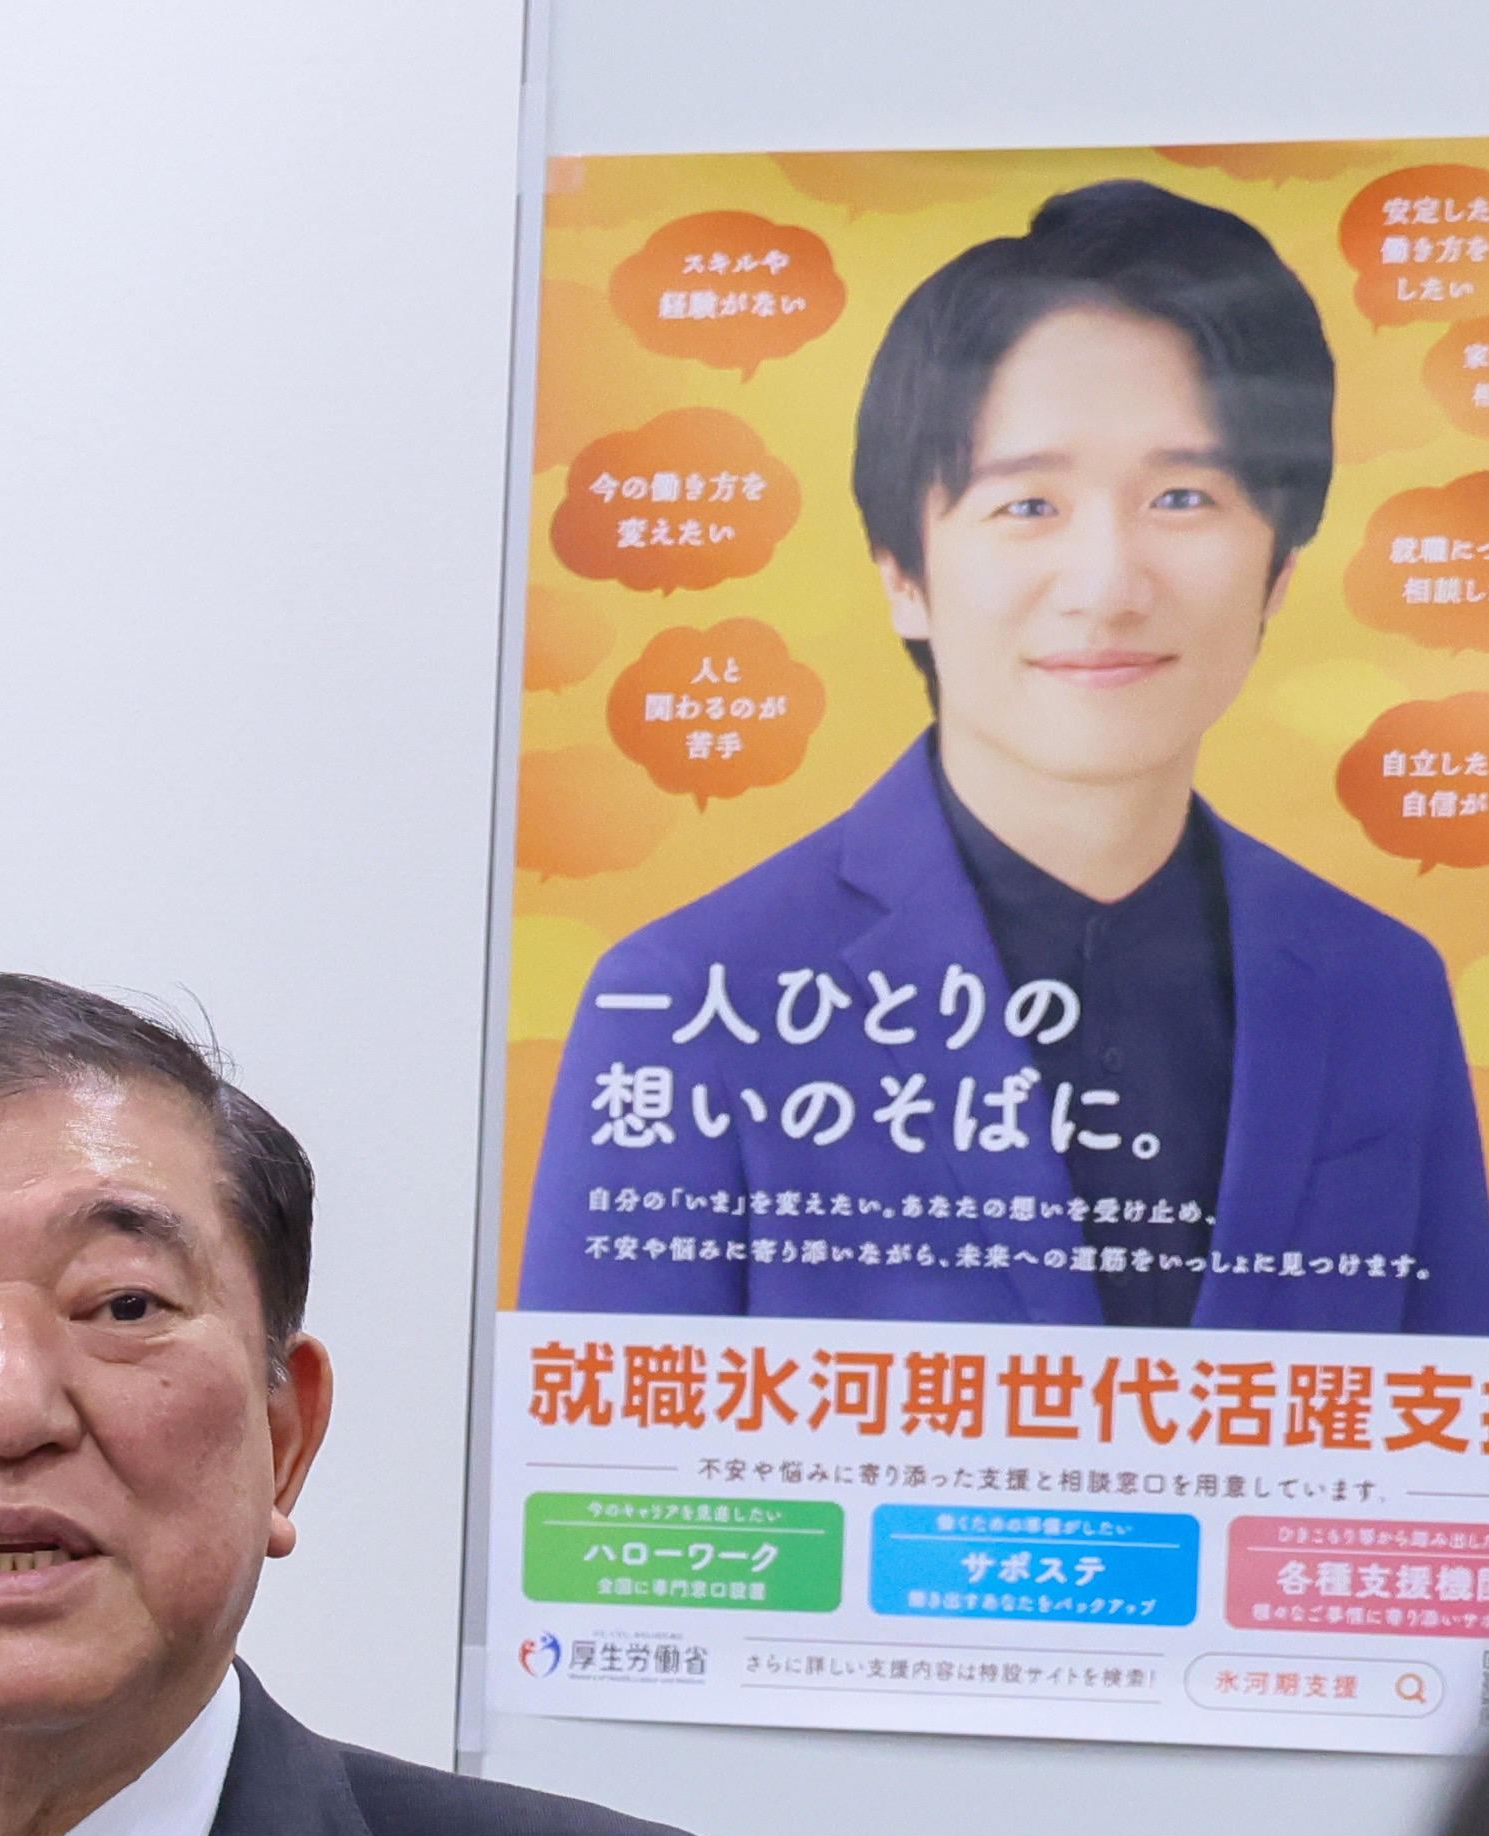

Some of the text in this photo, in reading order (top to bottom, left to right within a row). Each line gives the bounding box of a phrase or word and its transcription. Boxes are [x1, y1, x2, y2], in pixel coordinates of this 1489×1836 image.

[683, 248, 790, 275] スキルや
[657, 289, 808, 320] 経験がない
[1397, 276, 1475, 302] したい
[589, 472, 768, 502] 今の働き方を
[616, 517, 736, 548] 変えたい
[690, 656, 742, 684] 人と
[643, 692, 789, 722] 関わるのが
[684, 730, 744, 760] 苦手
[594, 961, 1082, 1051] 一人ひとりの
[590, 1061, 1161, 1161] 想いのそばに。
[583, 1541, 779, 1573] ハローワーク
[960, 1550, 1107, 1587] サポステ
[568, 1639, 709, 1675] 厚生労働省
[1215, 1669, 1359, 1700] 氷河期支援
